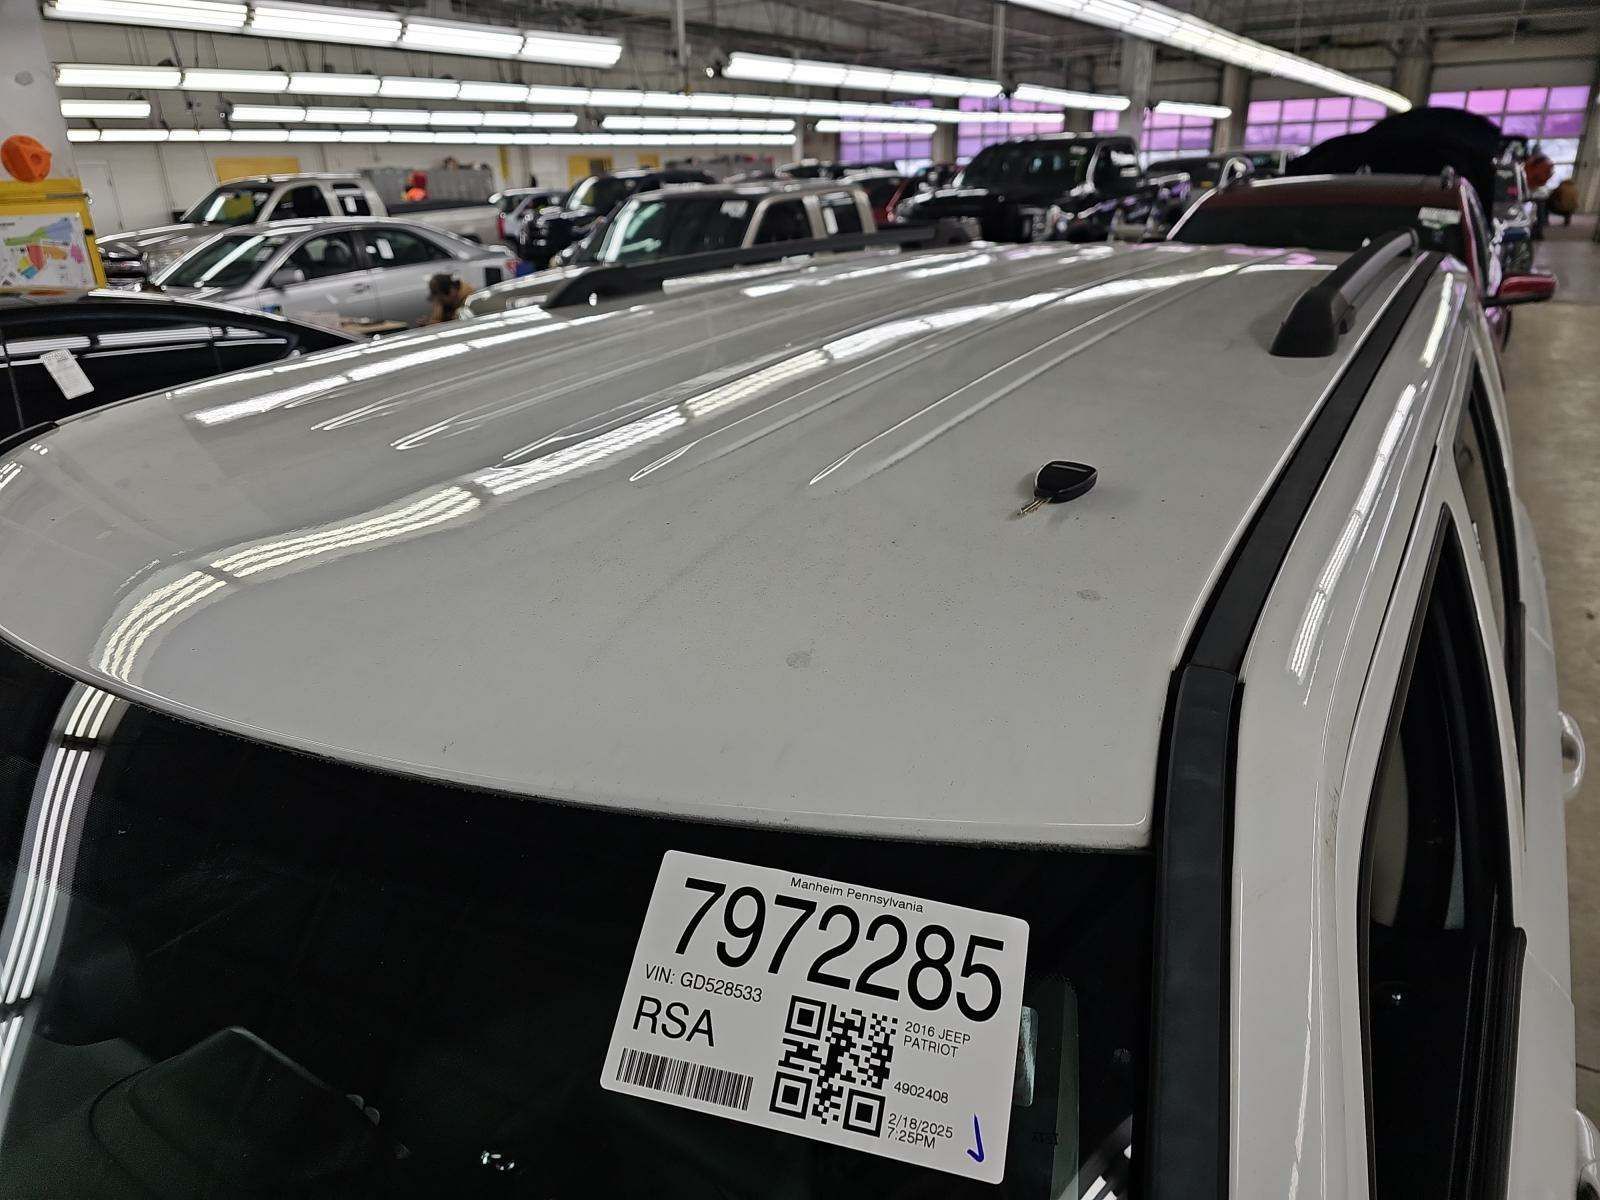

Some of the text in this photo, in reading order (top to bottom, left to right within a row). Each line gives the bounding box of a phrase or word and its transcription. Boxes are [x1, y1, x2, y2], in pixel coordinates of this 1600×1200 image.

[791, 877, 923, 913] Manheim Pennsylvania
[675, 877, 1004, 1022] 7972285
[645, 964, 763, 1002] VIN: GD528533
[633, 995, 715, 1047] RSA
[905, 1021, 971, 1045] 2016 JEEP
[903, 1035, 958, 1058] PATRIOT
[894, 1081, 949, 1103] 4902408
[887, 1126, 936, 1149] 7:25PM
[888, 1113, 953, 1138] 2/18/2025
